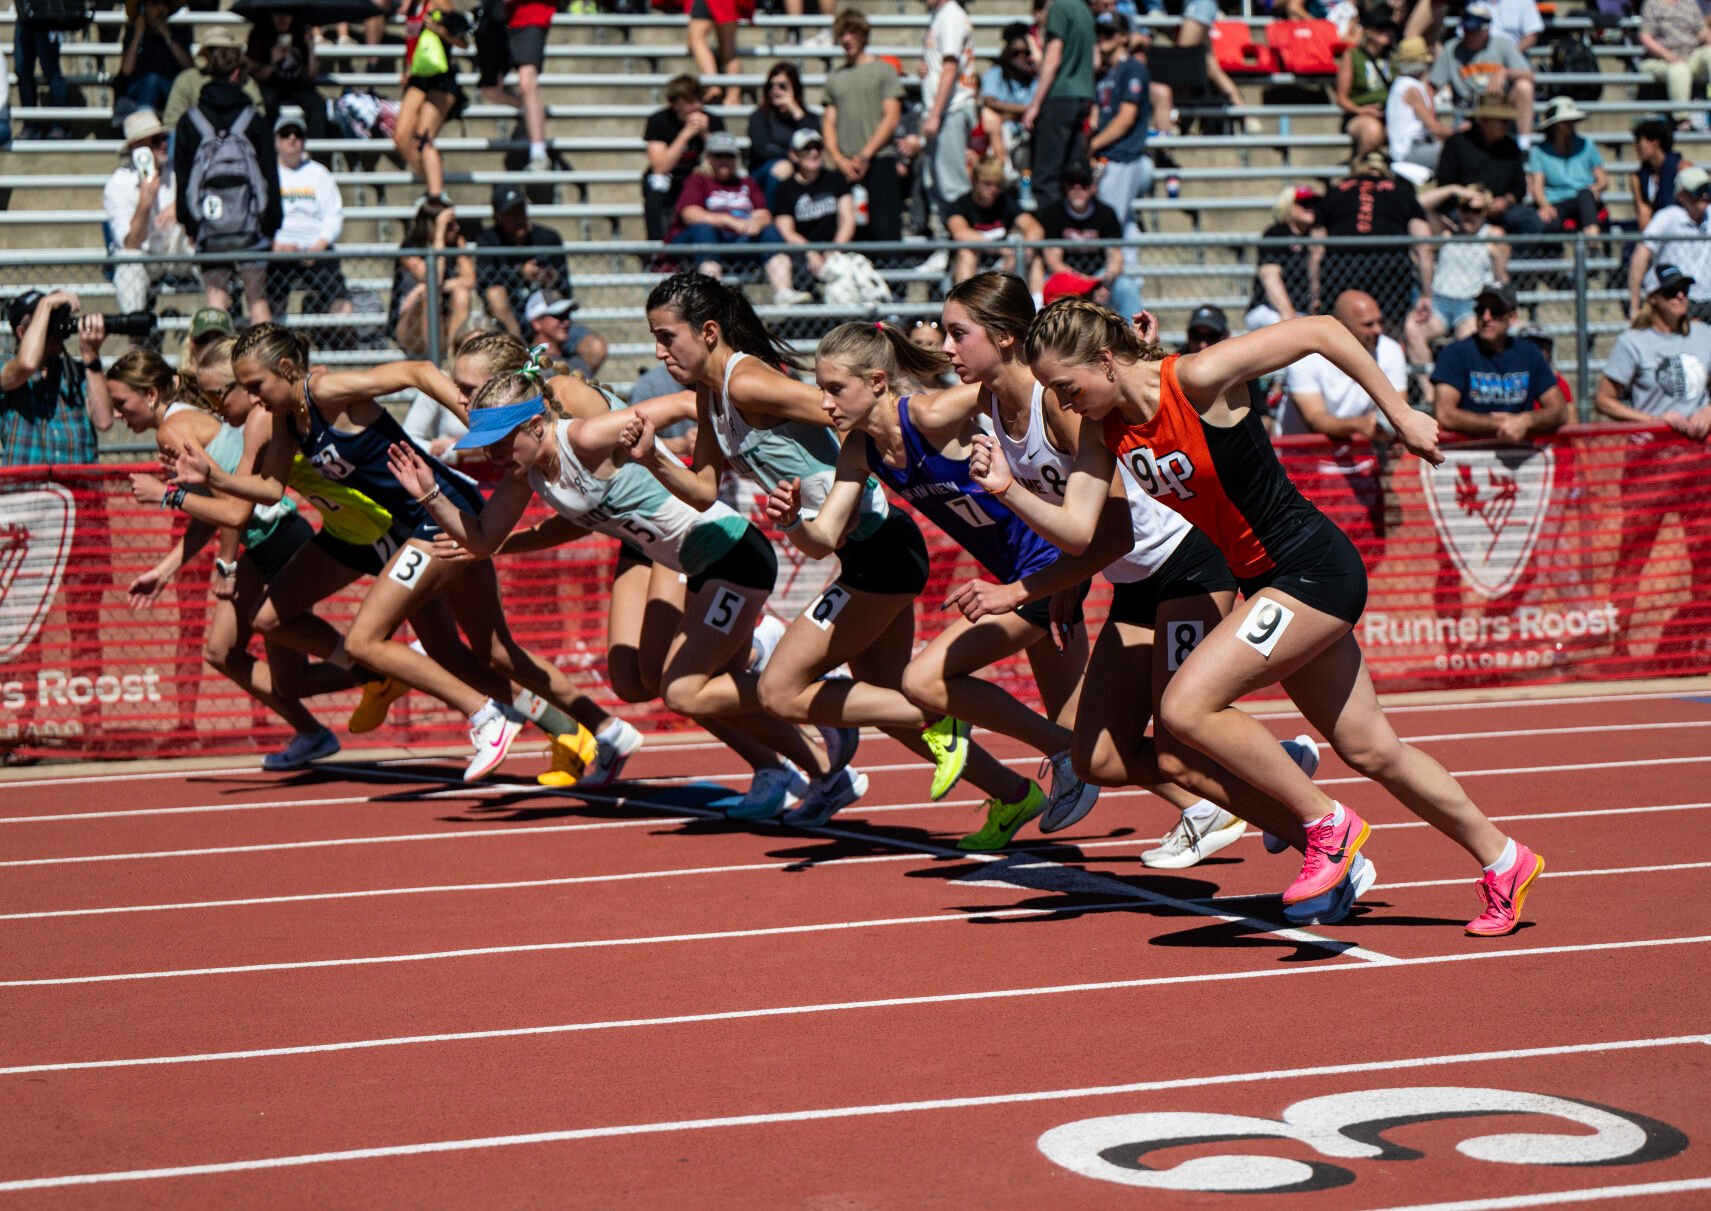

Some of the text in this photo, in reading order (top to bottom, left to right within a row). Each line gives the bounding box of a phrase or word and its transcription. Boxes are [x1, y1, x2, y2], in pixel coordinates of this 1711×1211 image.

[323, 450, 348, 475] 3
[1131, 453, 1158, 494] 9
[926, 481, 961, 496] VIEW
[1040, 465, 1067, 498] 8
[952, 499, 982, 525] 7
[622, 519, 657, 544] 5
[396, 550, 423, 581] 3
[711, 591, 740, 627] 5
[812, 588, 843, 624] 6
[1246, 603, 1283, 644] 9
[1364, 602, 1621, 645] Runners Roost
[1175, 623, 1197, 667] 8
[1434, 649, 1556, 671] COLORADO
[37, 667, 161, 707] Roost
[1037, 1087, 1688, 1193] 3
